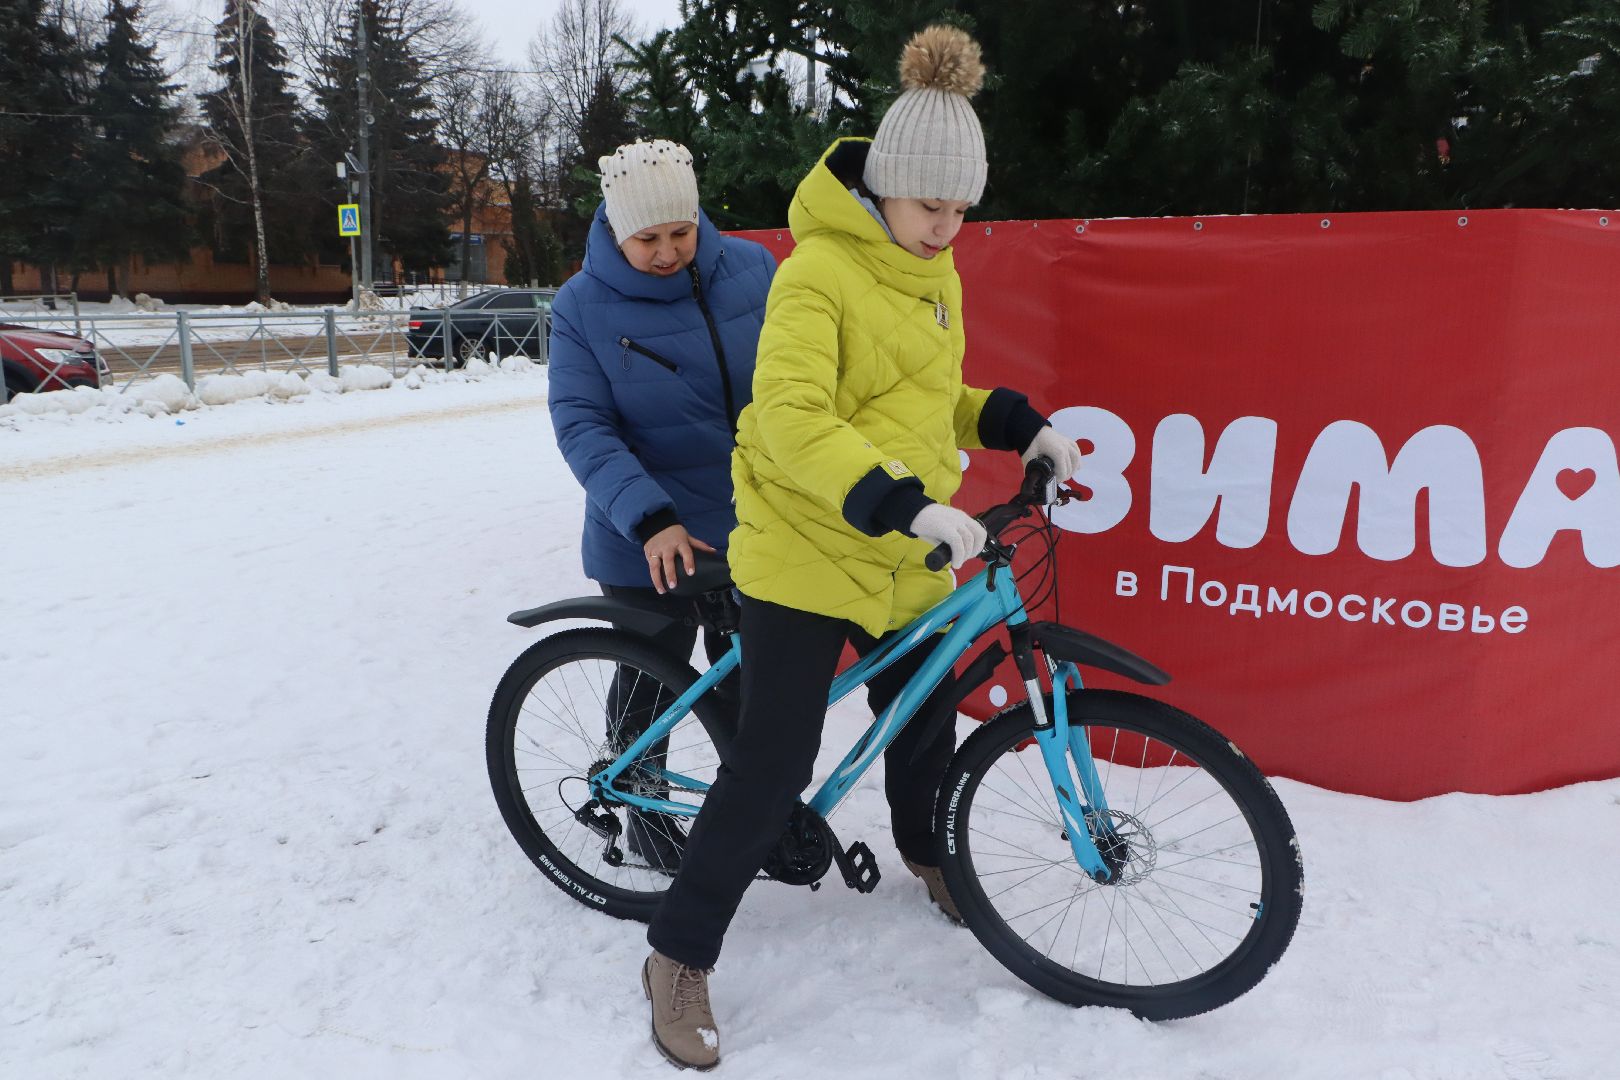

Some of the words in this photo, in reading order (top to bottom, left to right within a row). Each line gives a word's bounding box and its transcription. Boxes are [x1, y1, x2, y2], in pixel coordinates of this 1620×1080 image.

[1042, 406, 1620, 568] ЗИМА
[1115, 570, 1138, 597] в
[1160, 564, 1529, 634] Подмосковье
[949, 772, 970, 812] TERRAINS
[947, 813, 955, 830] ALL
[947, 831, 956, 855] CST
[538, 854, 572, 887] TERRAINS
[572, 882, 587, 895] ALL
[585, 892, 607, 905] CST
